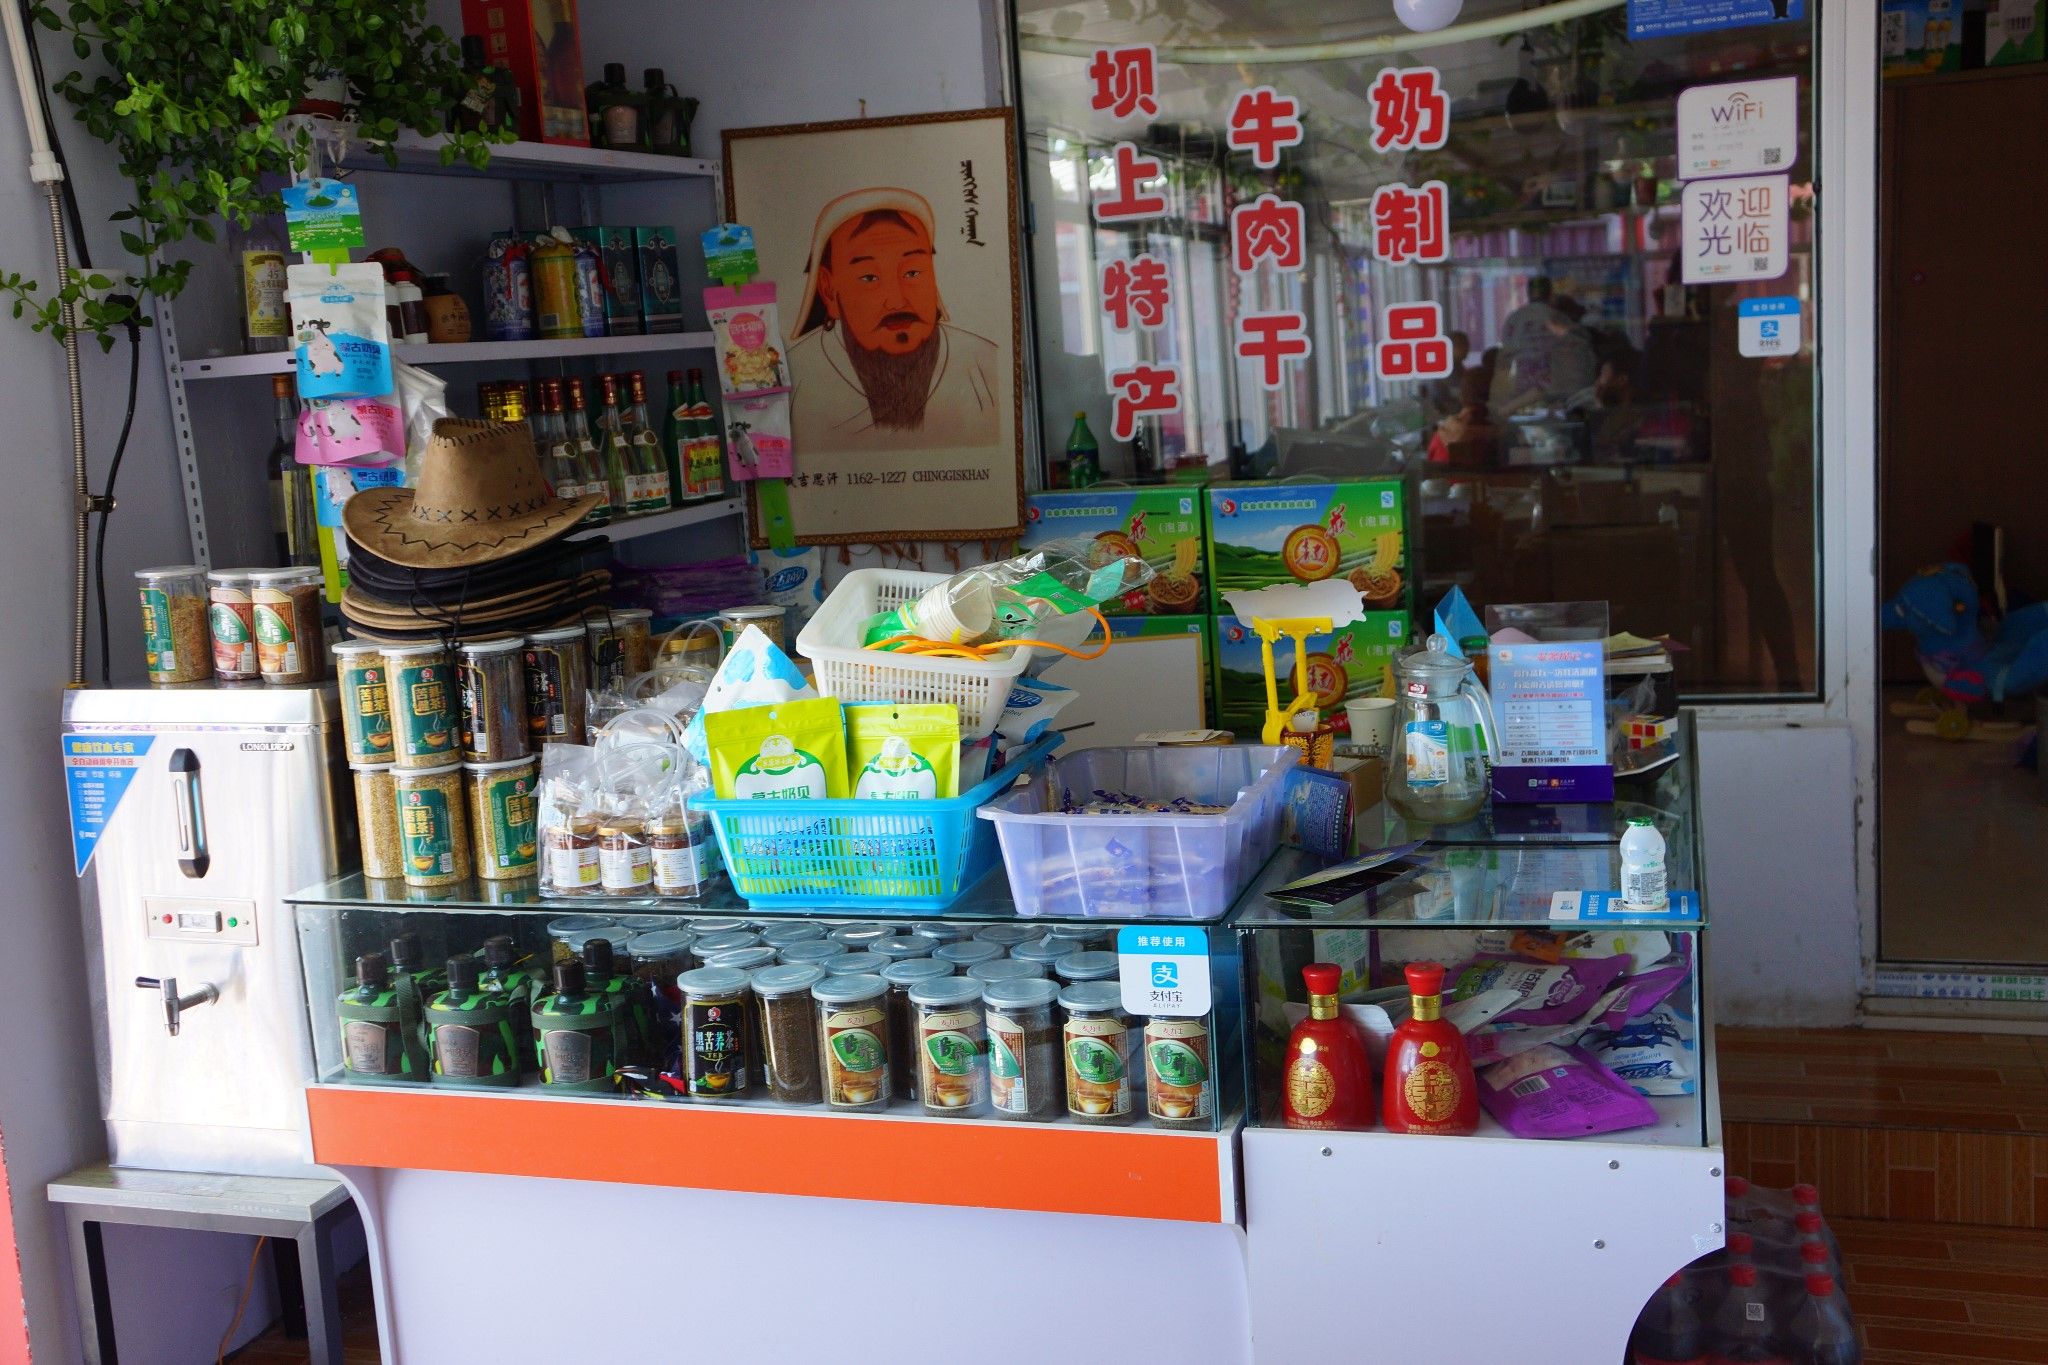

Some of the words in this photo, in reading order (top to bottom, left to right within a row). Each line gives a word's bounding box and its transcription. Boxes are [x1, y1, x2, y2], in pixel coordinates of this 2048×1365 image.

[1711, 101, 1764, 123] WiFi
[1698, 186, 1772, 222] 欢迎
[1231, 90, 1307, 385] 牛肉干
[1372, 70, 1448, 376] 奶制品
[1698, 222, 1771, 257] 光临
[1090, 47, 1178, 438] 坝上特产
[1137, 935, 1185, 947] 推荐使用
[1149, 990, 1182, 1002] 支付宝
